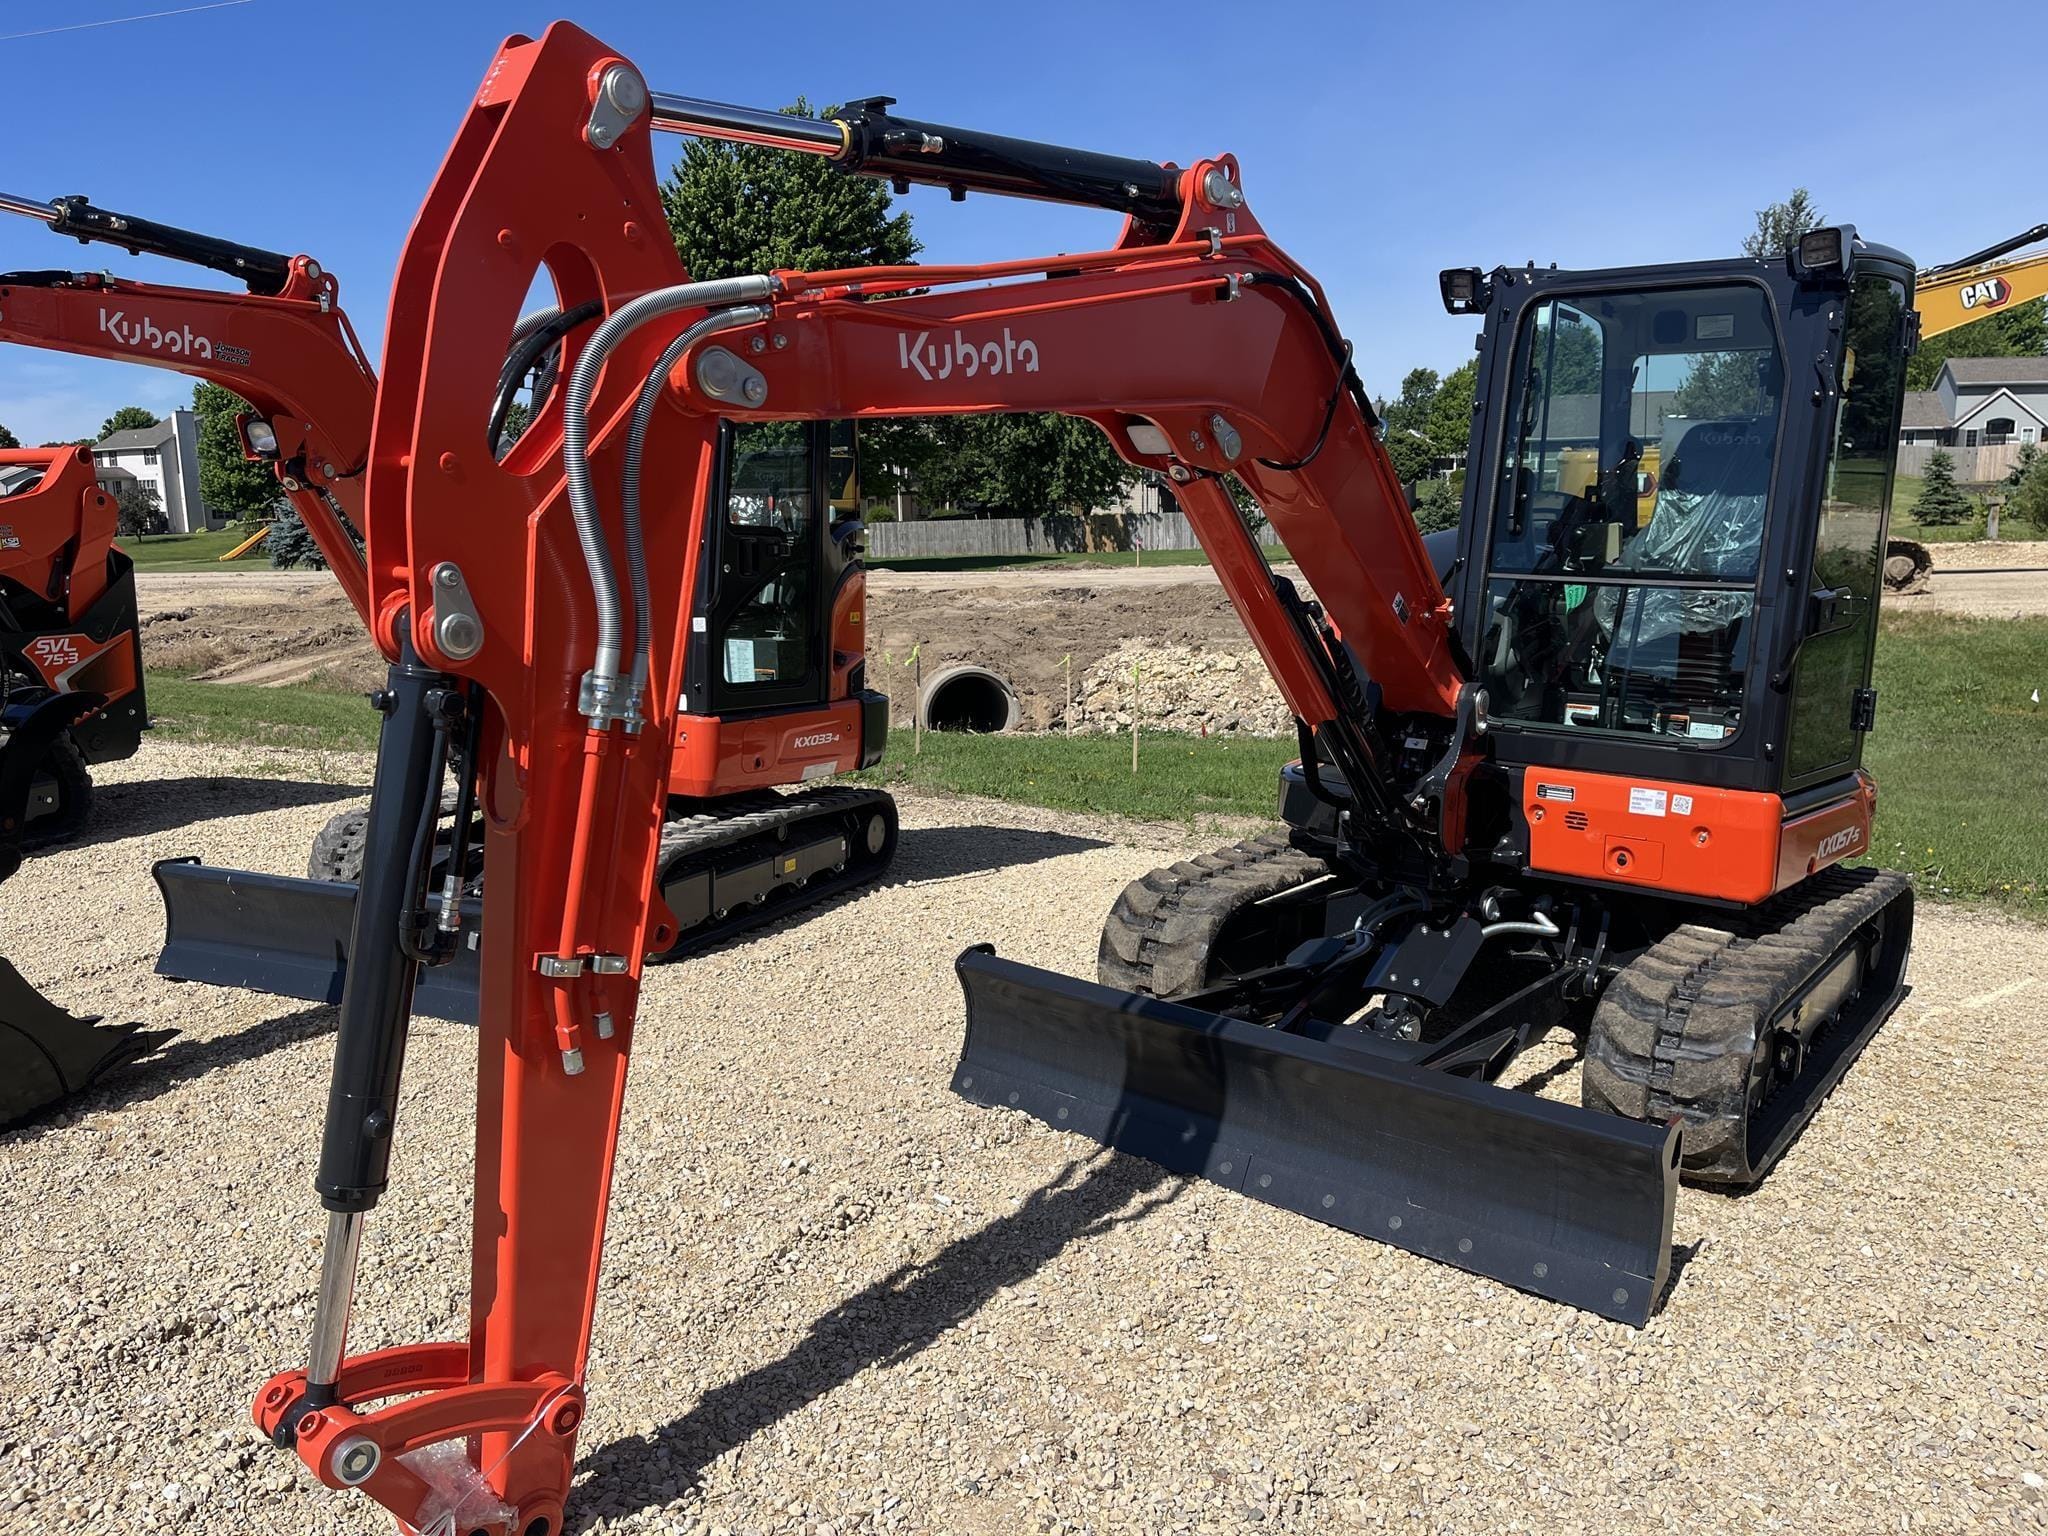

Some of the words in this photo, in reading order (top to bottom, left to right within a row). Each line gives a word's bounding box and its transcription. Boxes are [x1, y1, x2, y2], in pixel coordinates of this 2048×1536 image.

[1960, 278, 1998, 309] CAT
[99, 307, 213, 360] Kubota
[214, 341, 251, 358] JOHNSON
[898, 327, 1040, 381] Kubota
[215, 350, 251, 367] TRACTOR
[1700, 431, 1761, 446] Kubota
[34, 638, 77, 655] SVL
[43, 652, 79, 667] 75-3
[793, 732, 840, 749] KX033-4
